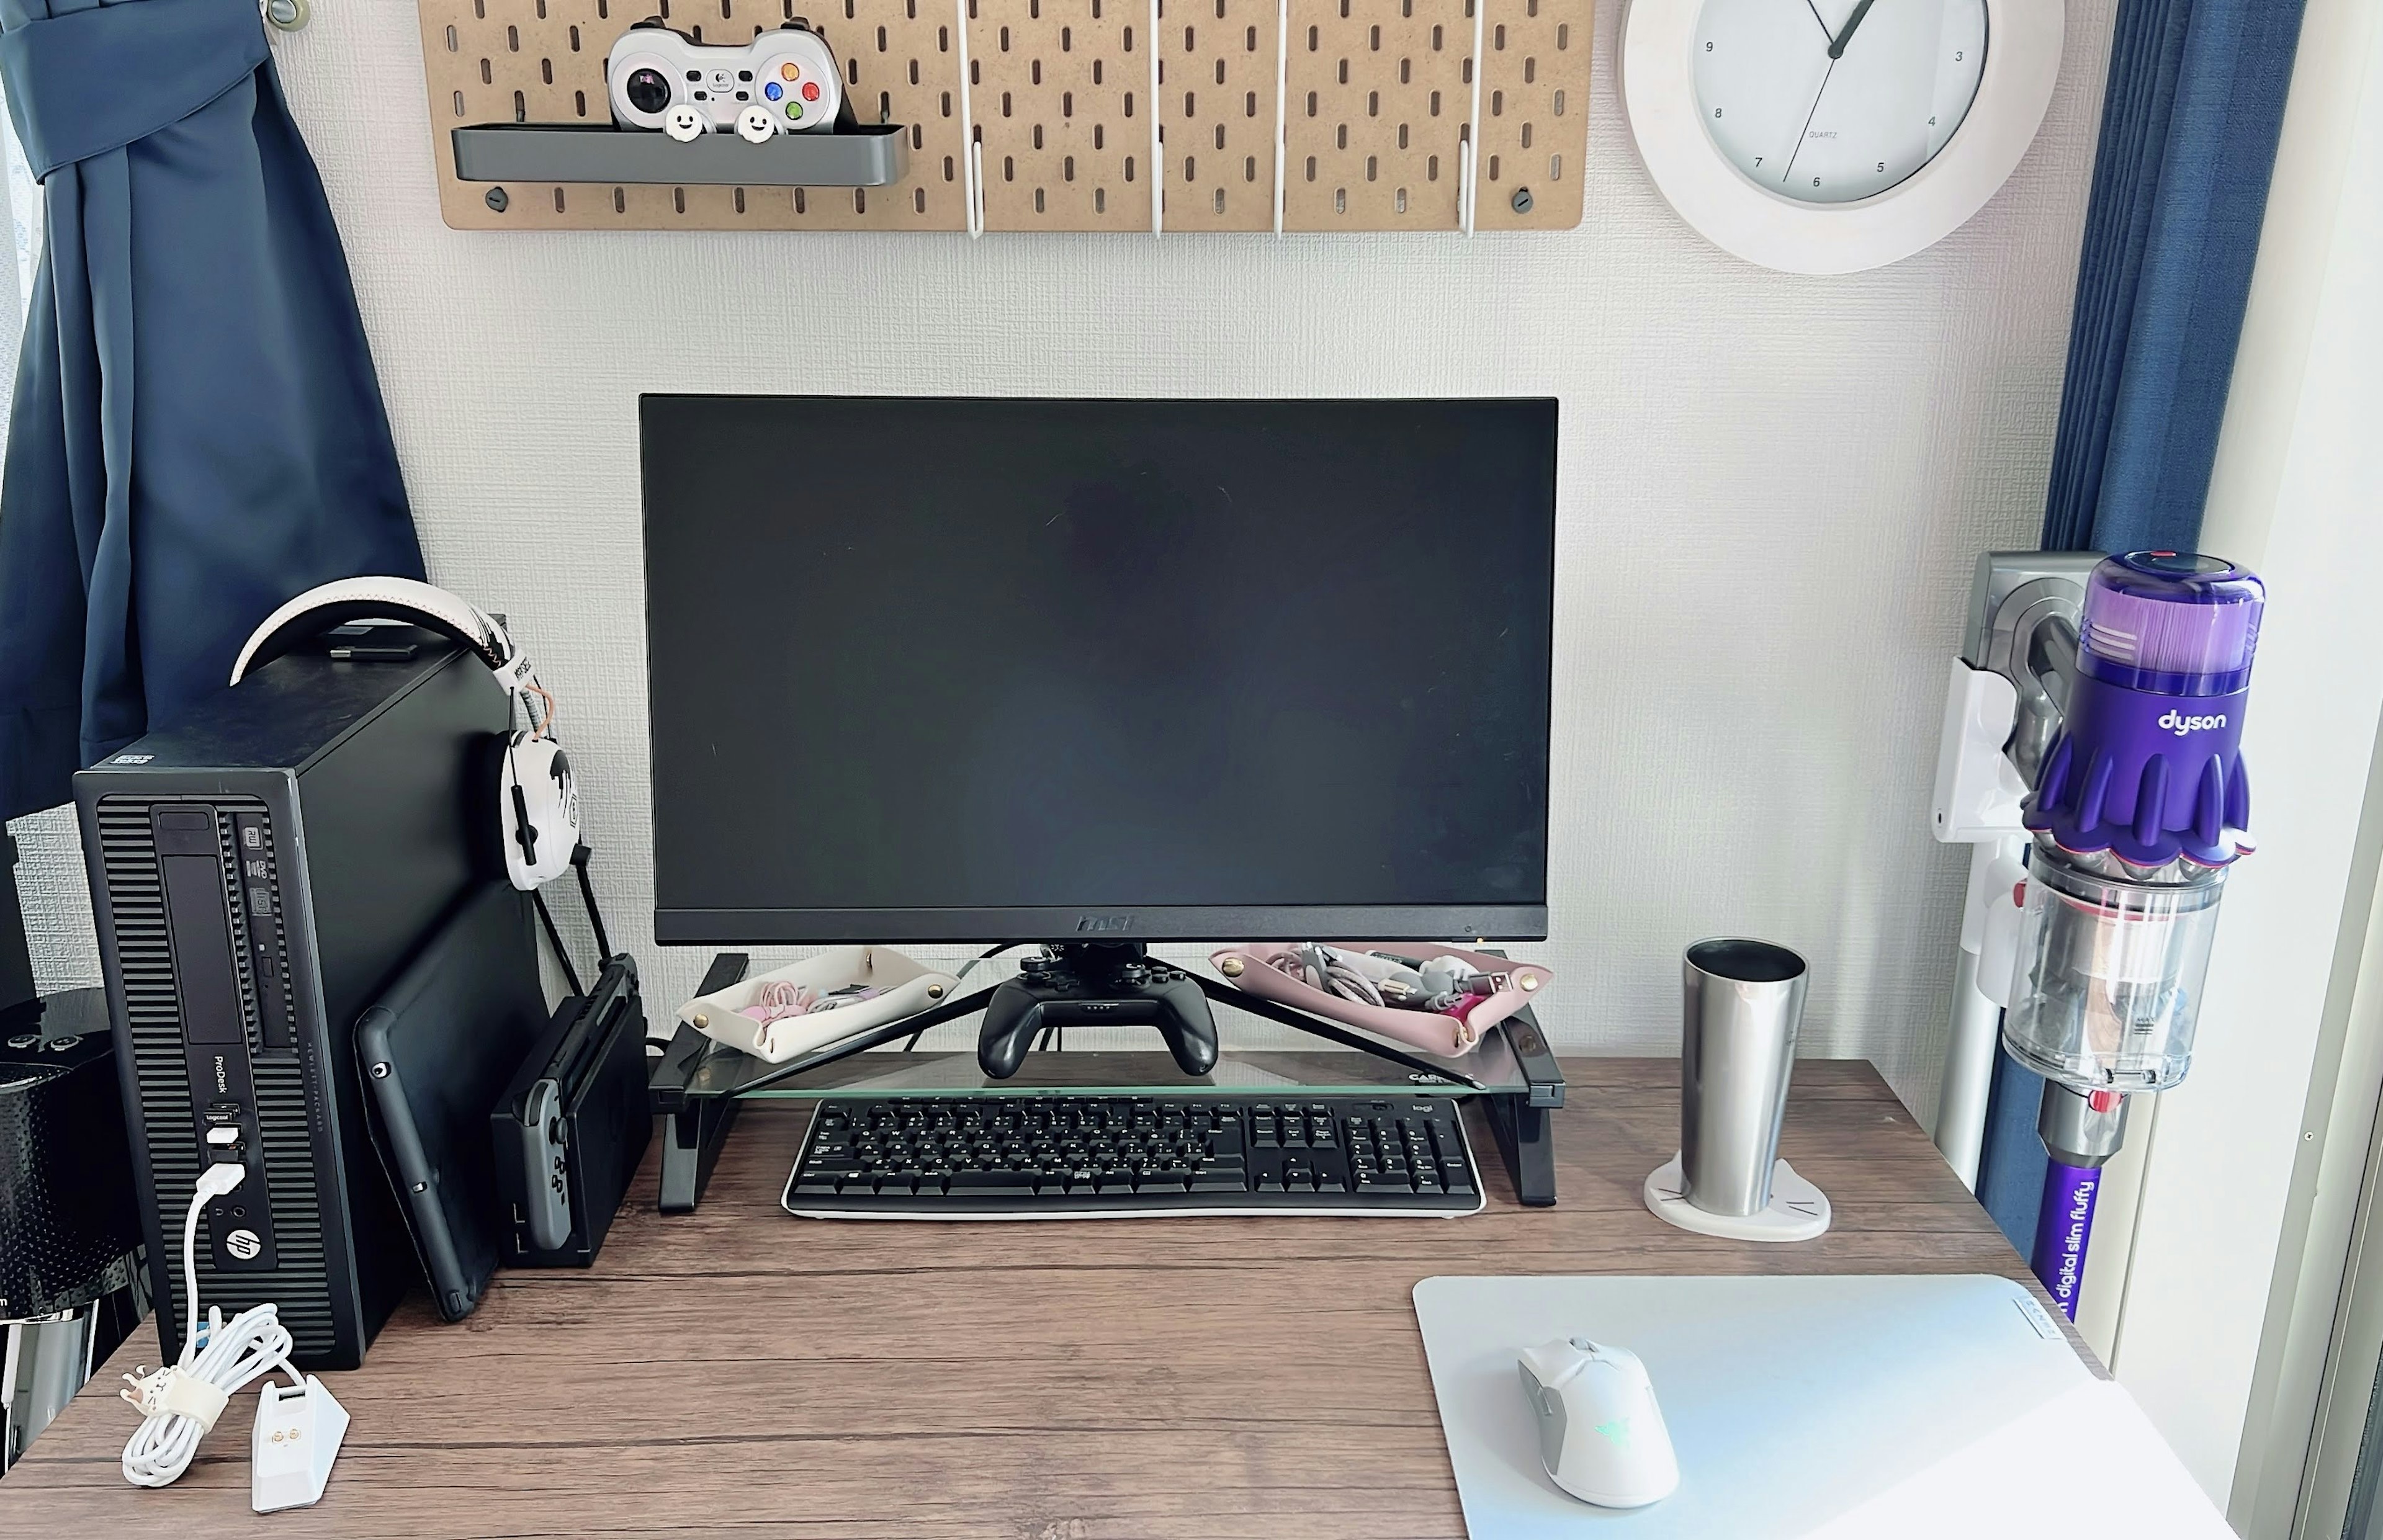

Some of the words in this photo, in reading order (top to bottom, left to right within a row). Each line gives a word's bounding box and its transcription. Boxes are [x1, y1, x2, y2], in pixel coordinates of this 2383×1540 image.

[1705, 42, 1713, 52] 9
[1955, 51, 1963, 62] 3
[1715, 107, 1722, 119] 8
[1927, 116, 1936, 127] 4
[1809, 131, 1837, 139] QUARTZ
[1755, 157, 1763, 168] 7
[1877, 162, 1885, 172] 5
[1813, 177, 1821, 187] 6
[2158, 709, 2227, 736] dyson
[214, 1056, 228, 1093] ProDesk
[1412, 1104, 1434, 1113] logi
[2069, 1181, 2096, 1221] fluffy
[2064, 1222, 2085, 1252] slim
[2055, 1253, 2079, 1298] digital
